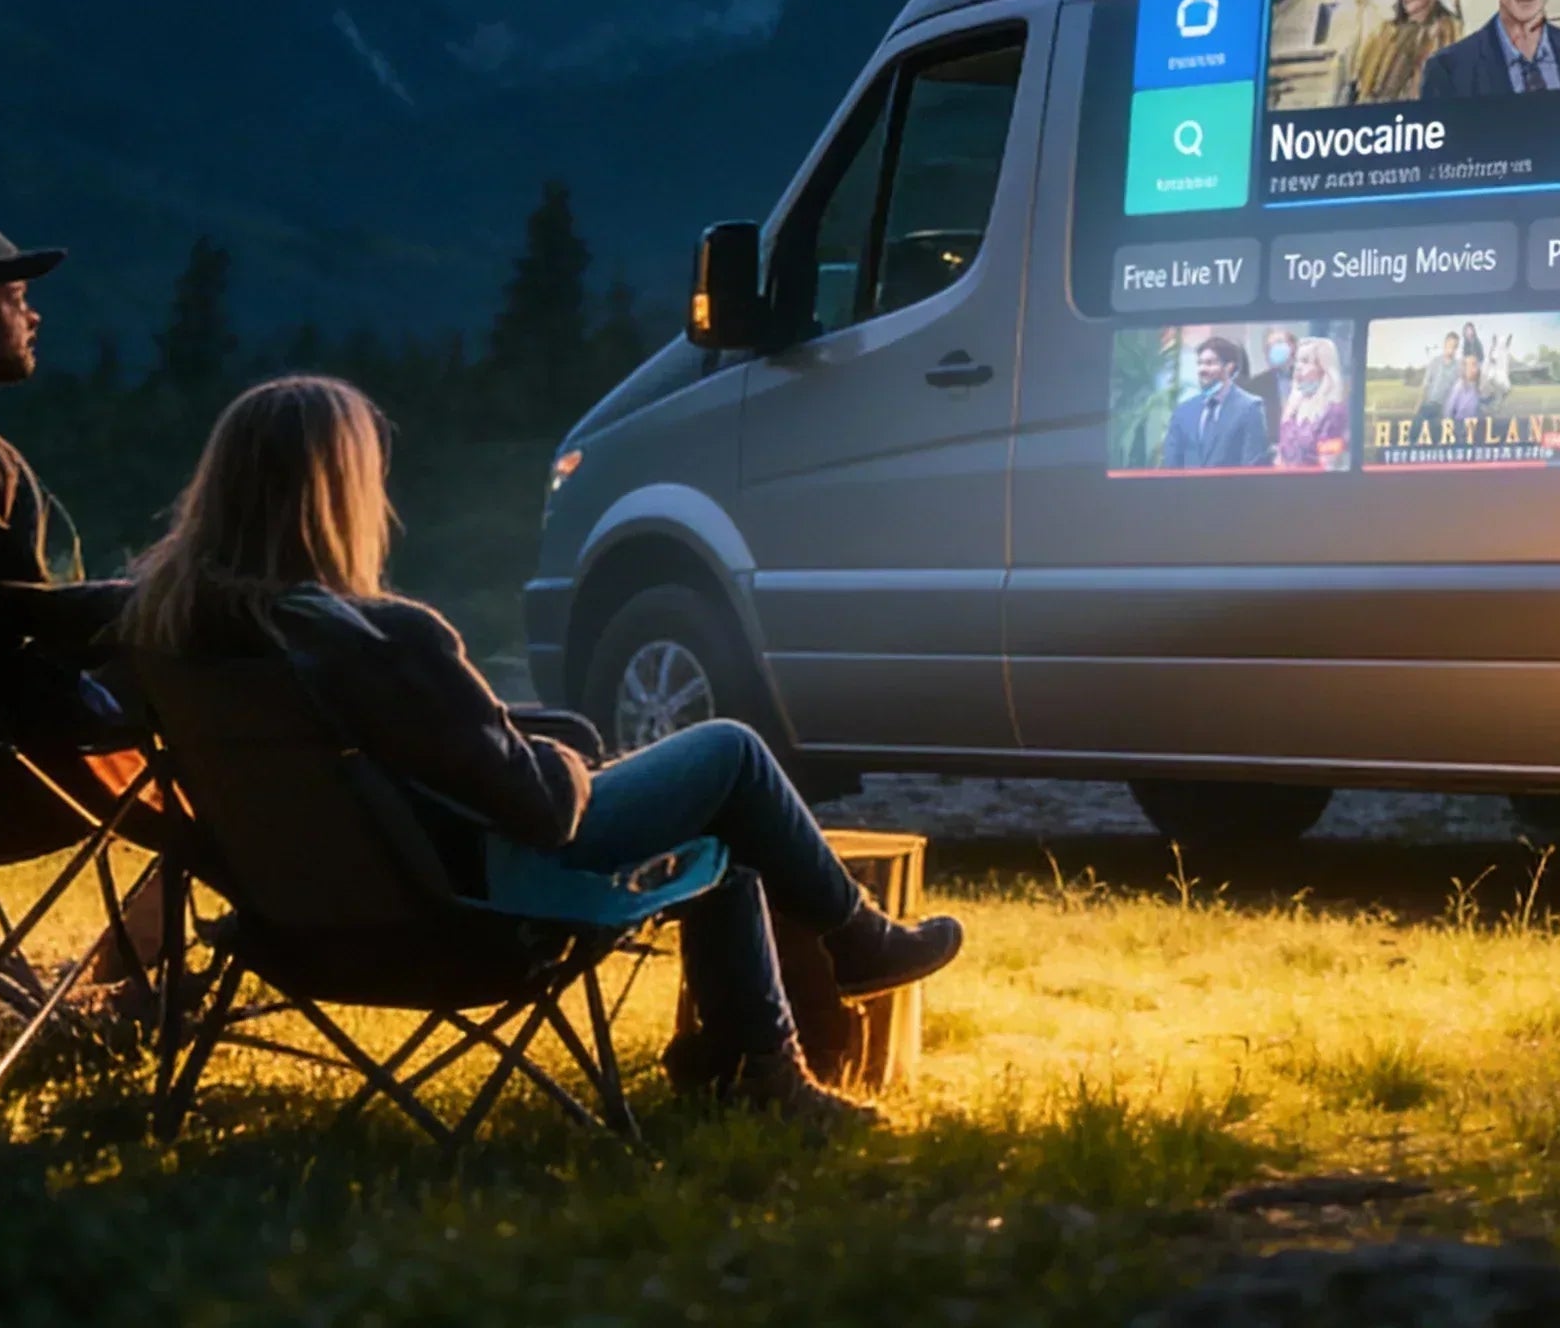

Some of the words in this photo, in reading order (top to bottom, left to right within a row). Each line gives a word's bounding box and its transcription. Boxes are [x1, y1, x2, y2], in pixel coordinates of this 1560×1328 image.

[1270, 112, 1446, 161] Novocaine
[1123, 261, 1167, 290] Free
[1172, 258, 1211, 287] Live
[1214, 255, 1243, 284] TV
[1284, 251, 1327, 286] Top
[1332, 247, 1408, 282] Selling
[1415, 240, 1497, 272] Movies
